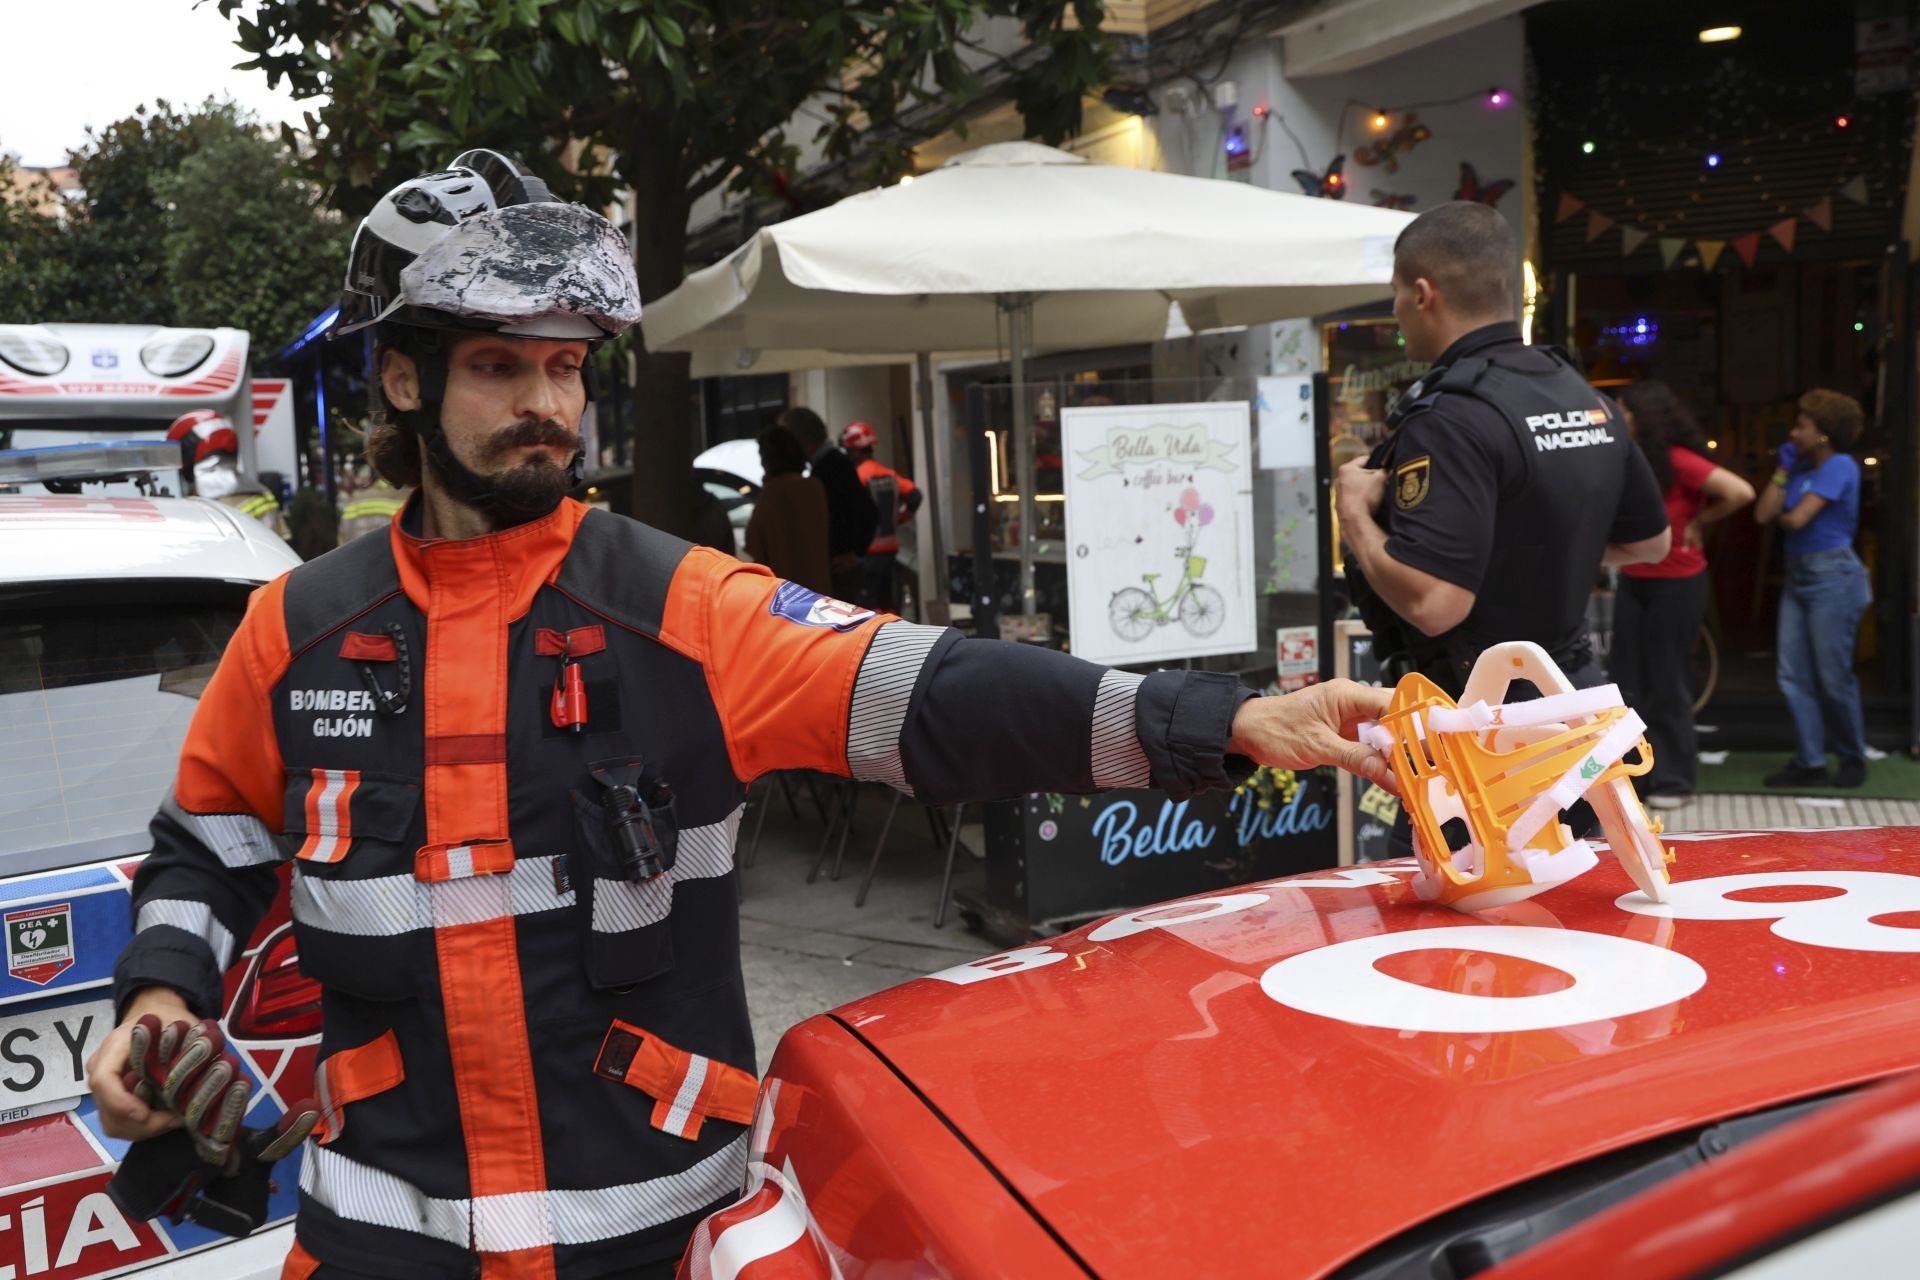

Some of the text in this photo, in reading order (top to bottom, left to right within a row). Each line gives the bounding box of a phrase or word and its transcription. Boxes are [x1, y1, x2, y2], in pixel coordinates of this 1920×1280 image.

[1111, 432, 1204, 460] Bella Vida
[1534, 427, 1615, 452] NACIONAL
[289, 689, 407, 714] BOMBER
[313, 713, 374, 737] GIJÓN
[1091, 778, 1333, 866] Bella Vida
[19, 919, 43, 930] DEA
[1, 1107, 29, 1122] FIED
